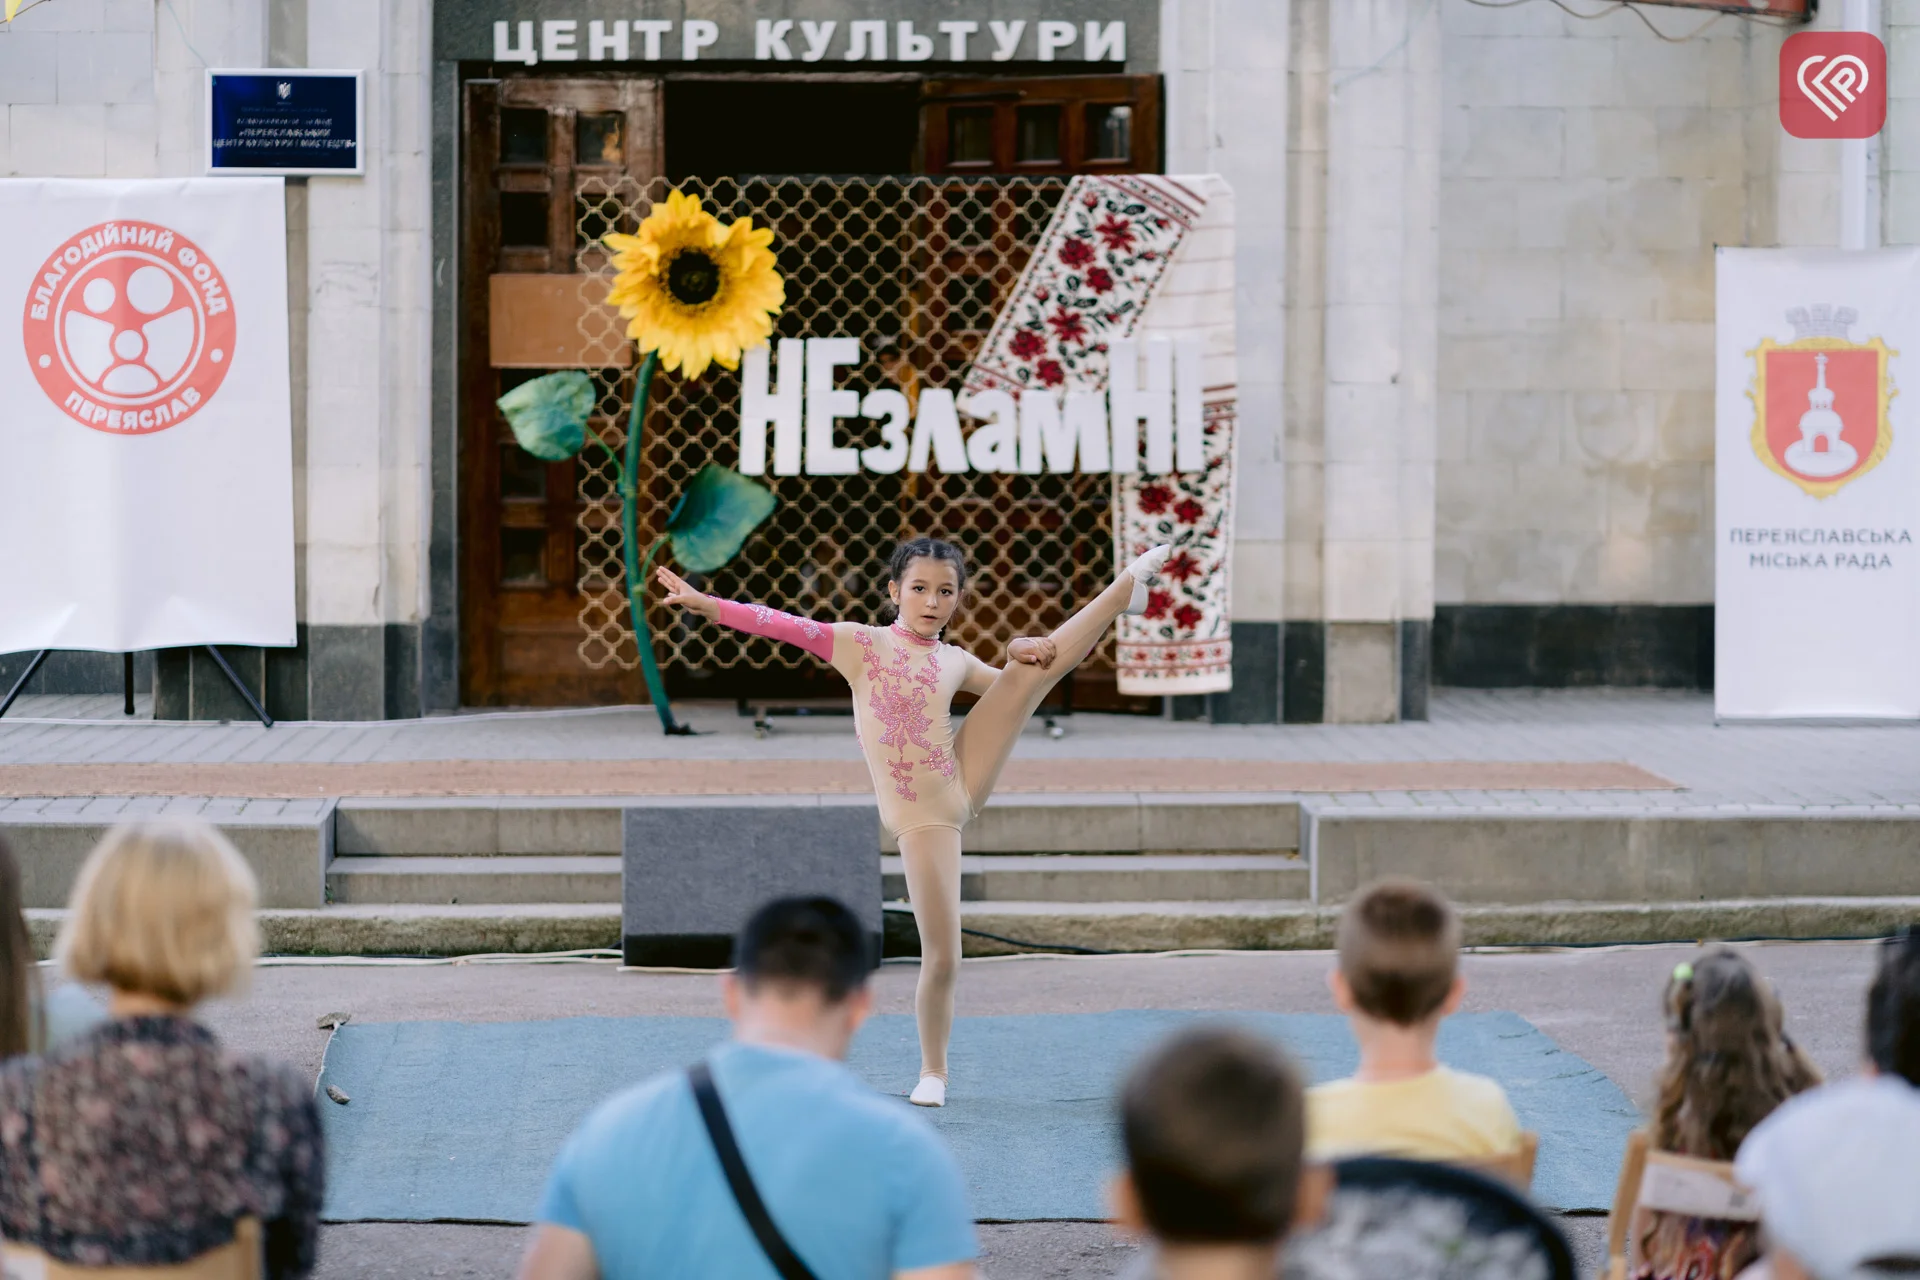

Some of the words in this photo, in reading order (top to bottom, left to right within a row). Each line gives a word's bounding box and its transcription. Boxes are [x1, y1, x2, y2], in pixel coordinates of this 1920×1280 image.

[492, 19, 720, 66] ЦЕНТР
[754, 19, 1127, 62] КУЛЬТУРИ
[30, 222, 175, 321] БЛАГОДІЙНИЙ
[177, 247, 229, 317] ФОНД
[64, 386, 202, 430] ПЕРЕЯСЛАВ
[738, 336, 1204, 477] НЕзламНІ
[1729, 527, 1913, 545] ПЕРЕЯСЛАВСЬКА
[1749, 551, 1829, 569] МІСЬКА
[1834, 551, 1893, 570] РАДА
